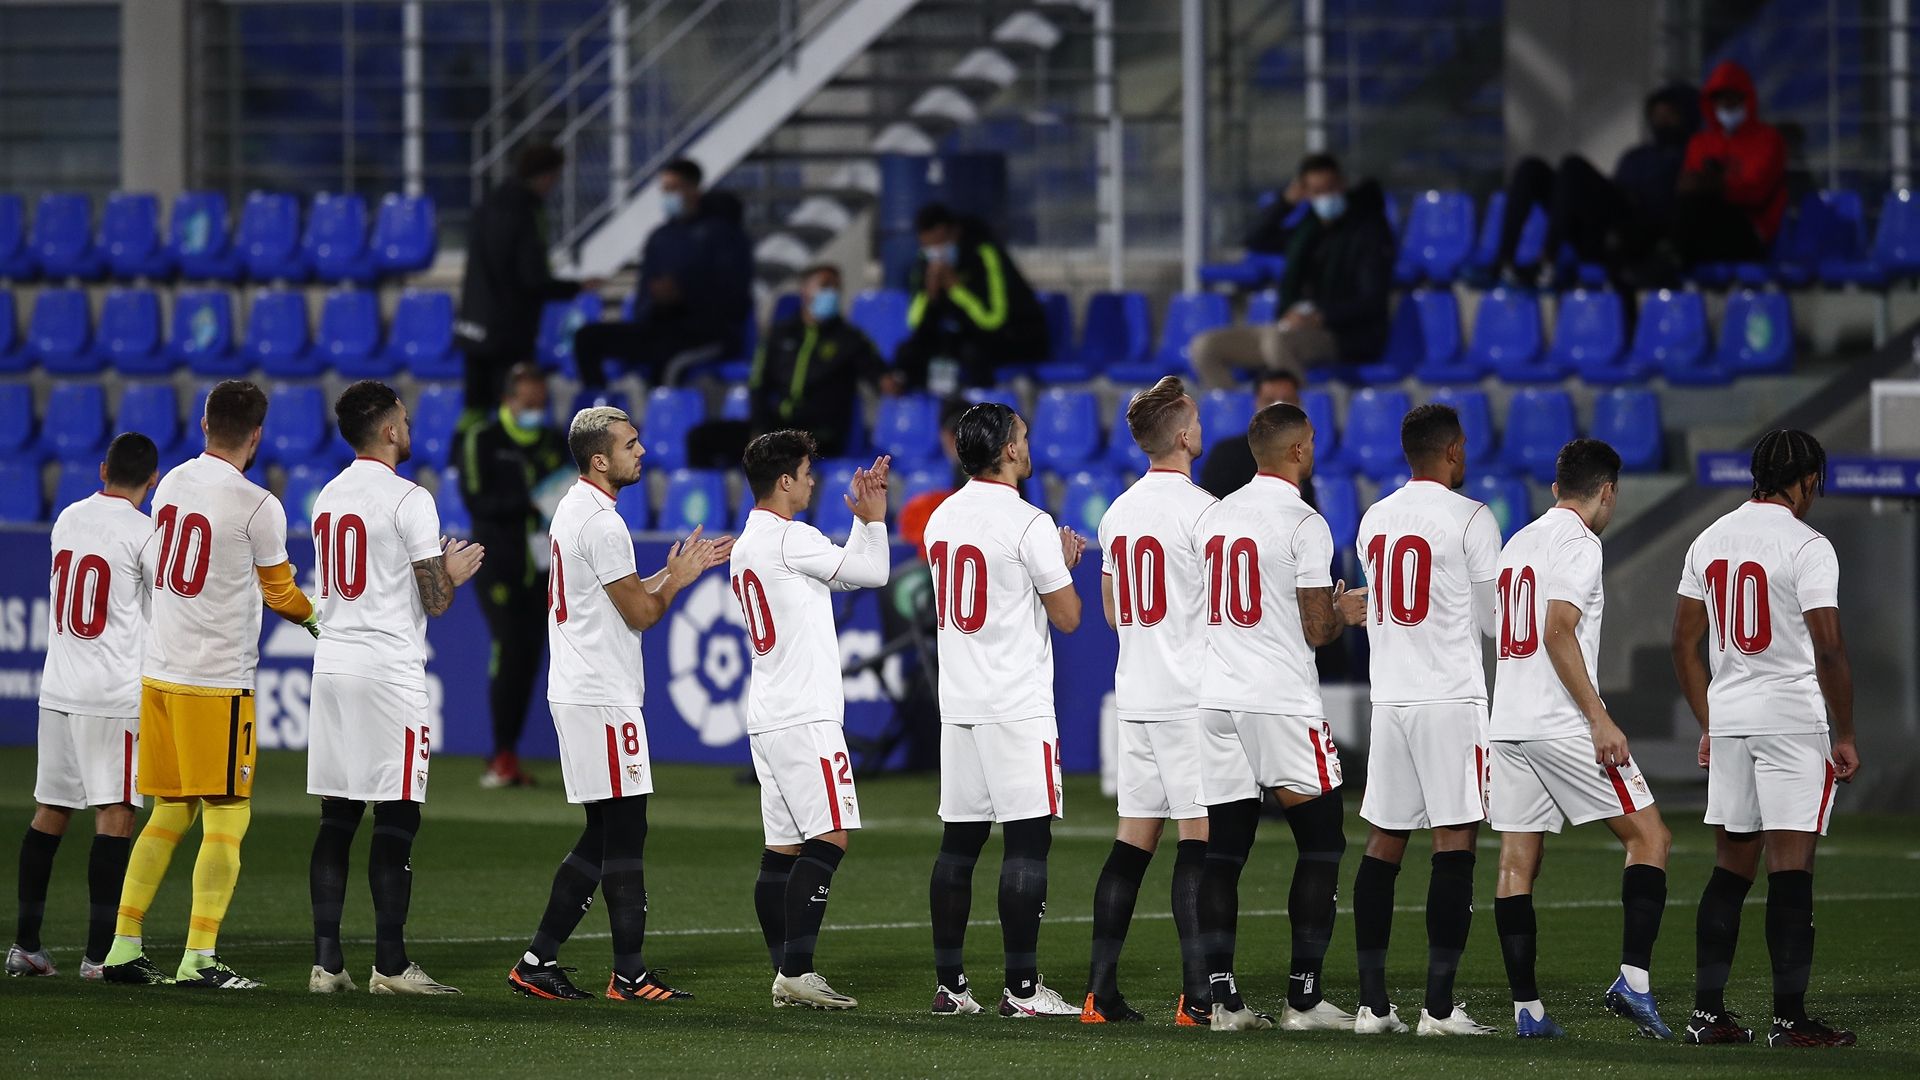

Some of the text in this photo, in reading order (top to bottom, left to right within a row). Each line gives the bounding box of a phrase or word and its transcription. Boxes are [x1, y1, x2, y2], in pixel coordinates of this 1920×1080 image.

[52, 550, 111, 641] 10
[156, 504, 212, 598] 10
[313, 512, 368, 600] 10
[931, 540, 989, 635] 10
[1110, 535, 1168, 627] 10
[1205, 535, 1264, 628] 10
[1368, 535, 1433, 626] 10
[1497, 565, 1540, 659] 10
[1703, 559, 1772, 656] 10
[242, 722, 253, 756] 1
[418, 726, 431, 761] 5
[621, 722, 640, 757] 8
[833, 751, 852, 785] 2
